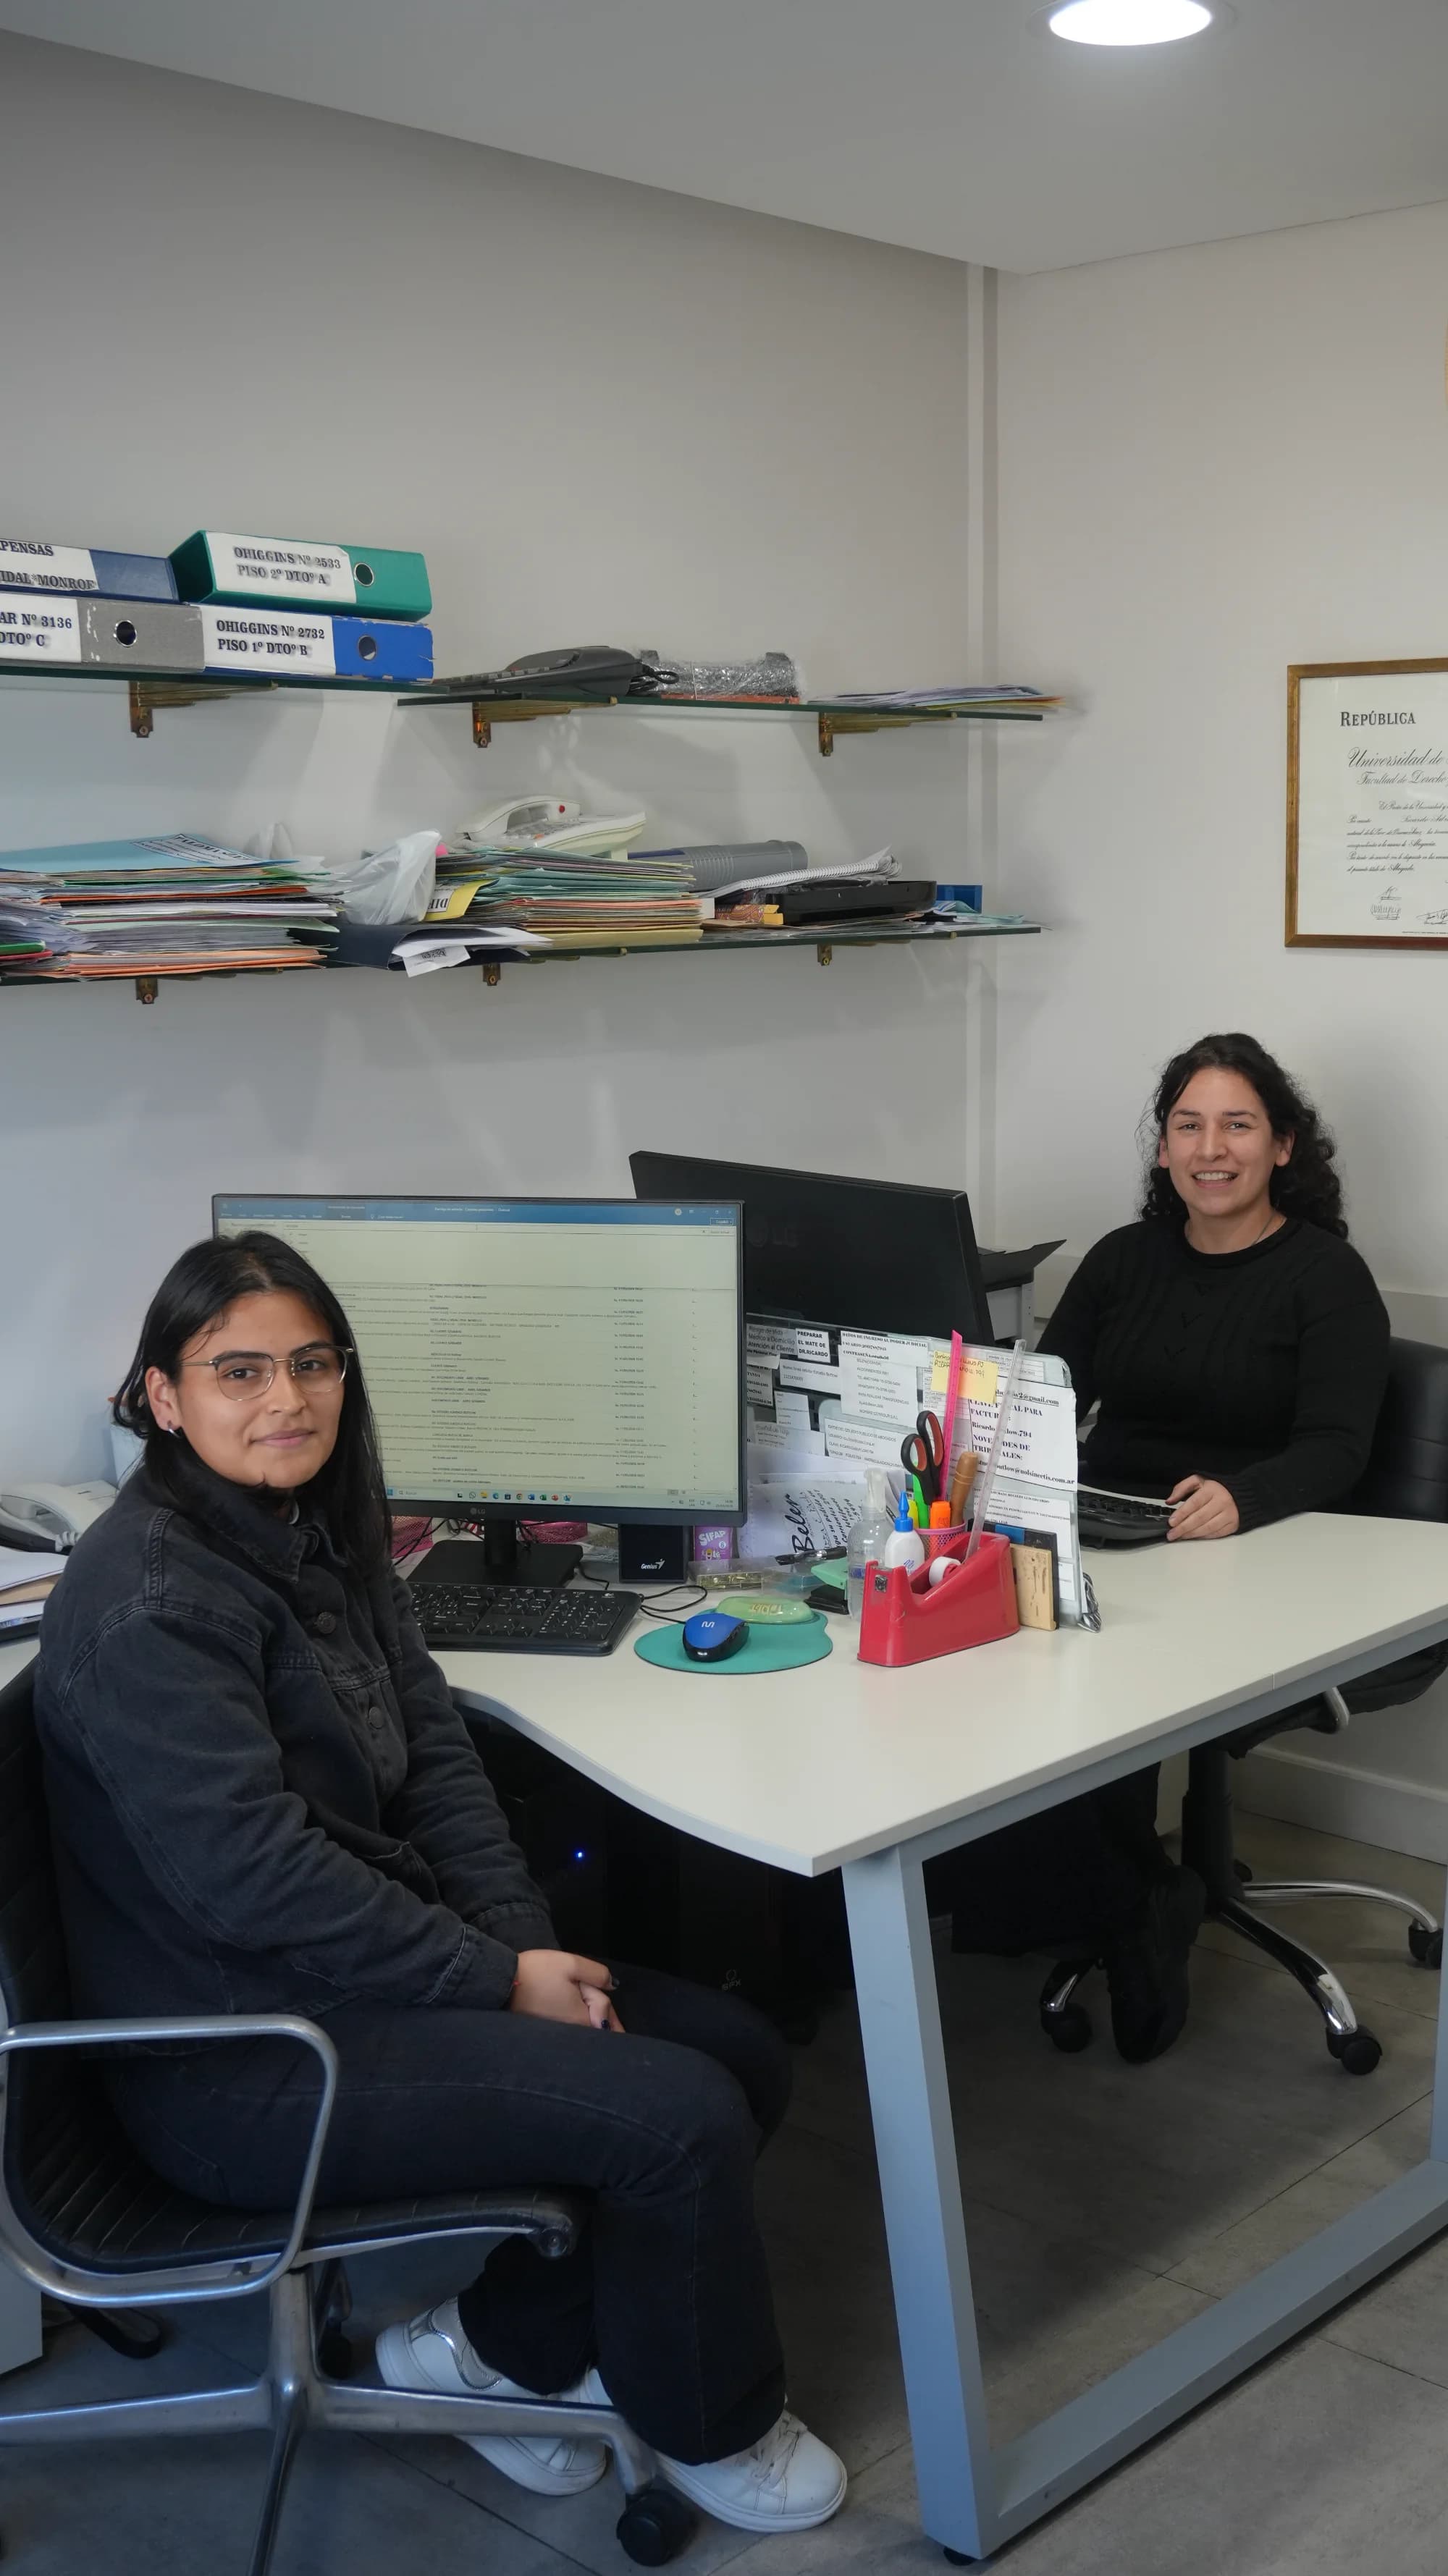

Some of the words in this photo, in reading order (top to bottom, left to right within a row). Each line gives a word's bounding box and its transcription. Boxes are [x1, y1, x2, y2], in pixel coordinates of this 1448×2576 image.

[0, 541, 54, 556] PENSAS
[234, 546, 295, 564] OHIGGINS
[314, 558, 340, 569] 2533
[237, 565, 266, 578] PISO
[319, 573, 327, 585] A
[0, 612, 17, 625] AR
[41, 615, 72, 628] 3136
[216, 620, 278, 635] OHIGGINS
[298, 627, 324, 639] 2732
[36, 634, 45, 646] C
[218, 638, 247, 651] PISO
[300, 644, 308, 656] B
[1348, 747, 1432, 767] Universidad
[771, 1336, 796, 1346] Domicilio
[797, 1330, 822, 1339] PREPARAR
[776, 1344, 795, 1354] Cliente
[799, 1348, 829, 1358] DR.RICARDO
[1024, 1406, 1043, 1416] PARA
[1019, 1443, 1030, 1451] DE
